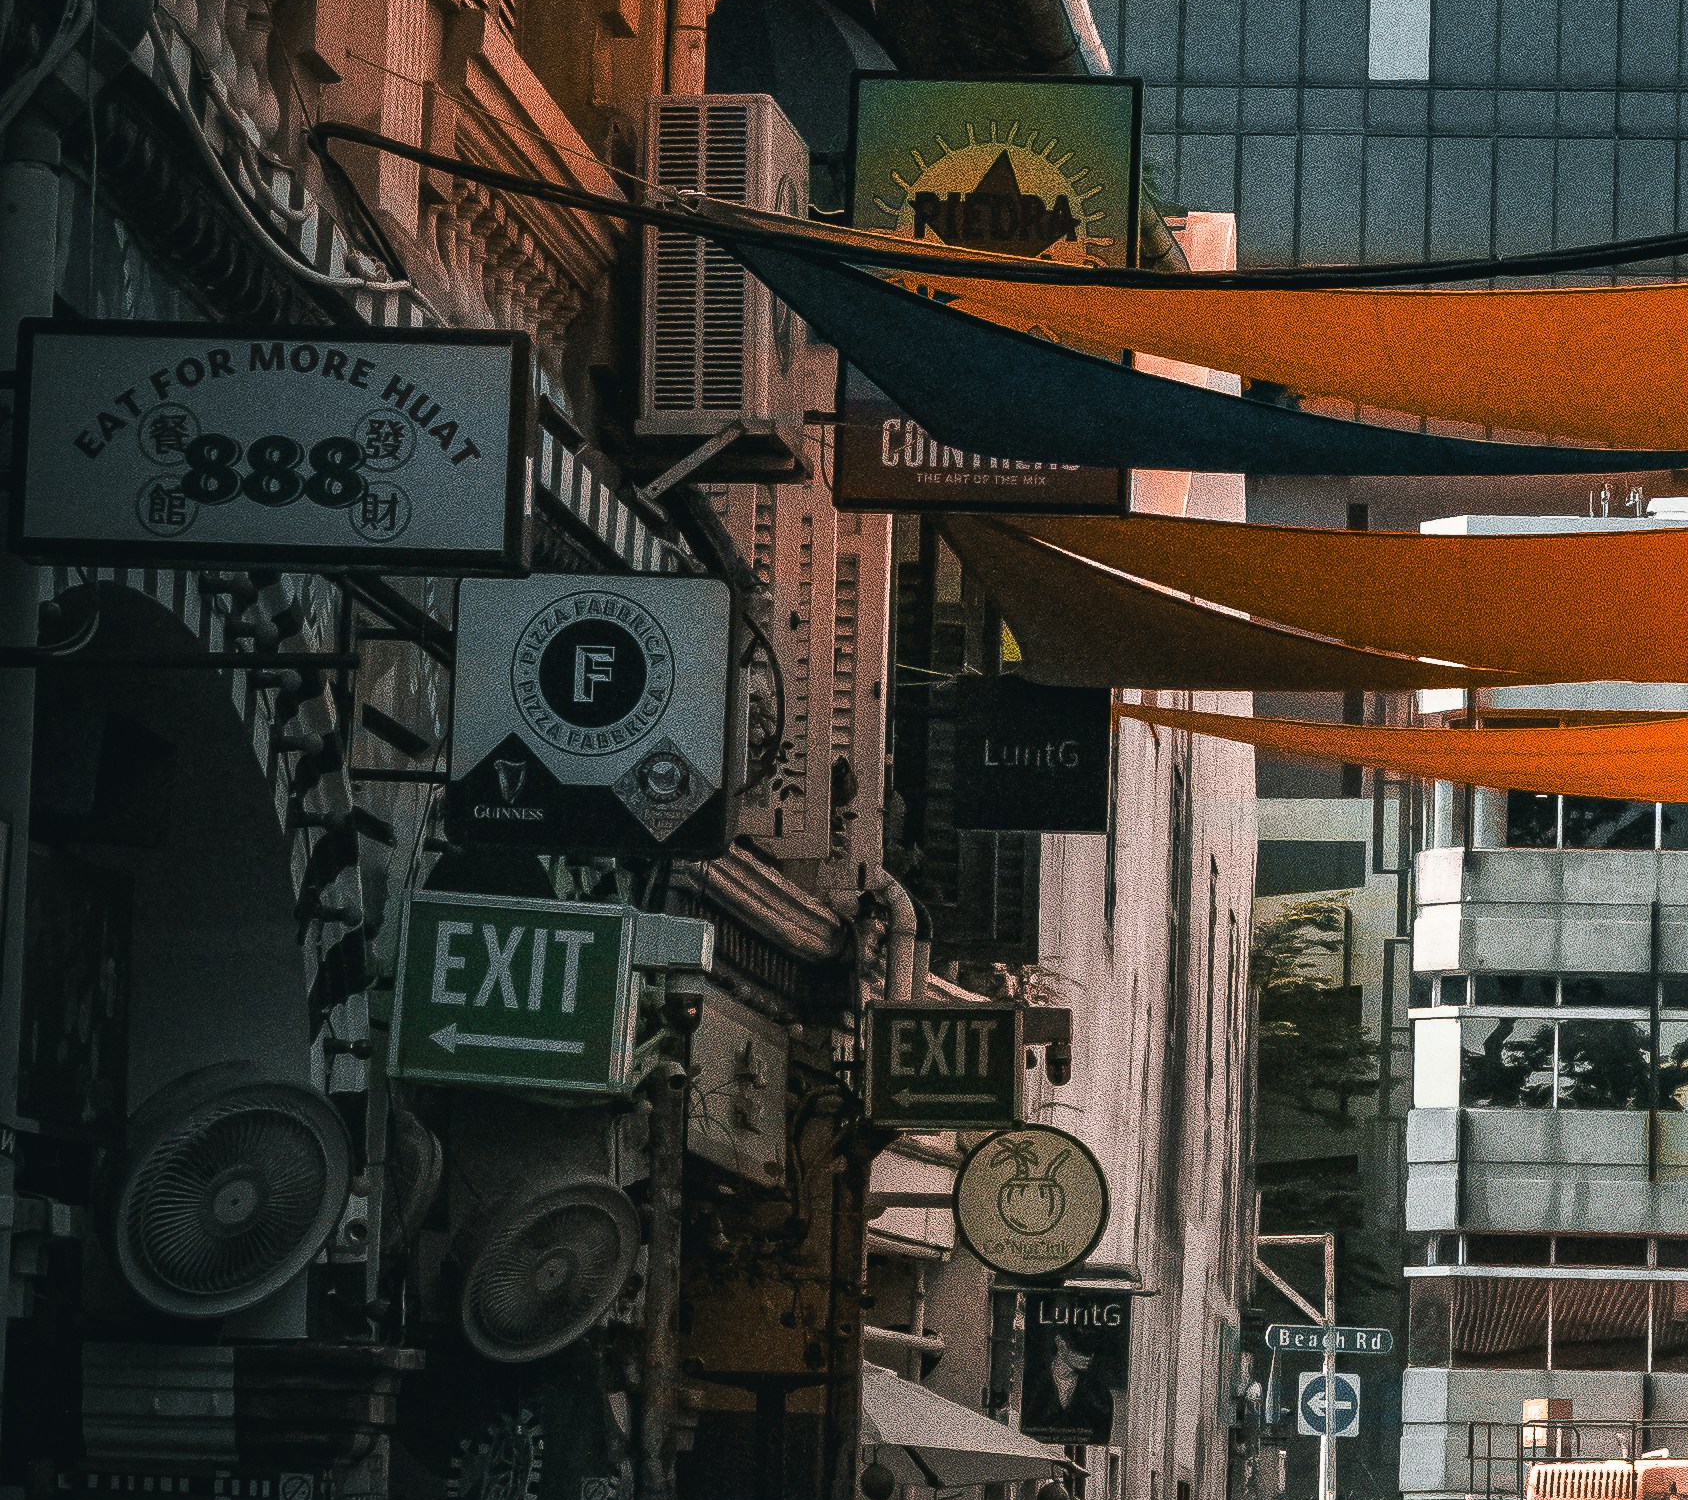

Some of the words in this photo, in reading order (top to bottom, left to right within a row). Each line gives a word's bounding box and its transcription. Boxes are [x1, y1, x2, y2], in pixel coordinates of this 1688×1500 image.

[73, 387, 145, 460] EAT
[149, 347, 236, 402] FOR
[249, 341, 376, 390] MORE
[381, 374, 481, 467] HUAT
[181, 432, 371, 510] 888
[916, 472, 941, 485] THE
[944, 472, 969, 485] ART
[993, 473, 1020, 486] THE
[1022, 474, 1048, 487] MIX
[519, 607, 570, 665] PIZZA
[572, 644, 617, 702] F
[517, 679, 562, 741] PIZZA
[473, 803, 545, 821] GUINNESS
[431, 920, 596, 1014] EXIT
[889, 1018, 999, 1079] EXIT
[1356, 1331, 1381, 1351] Rd
